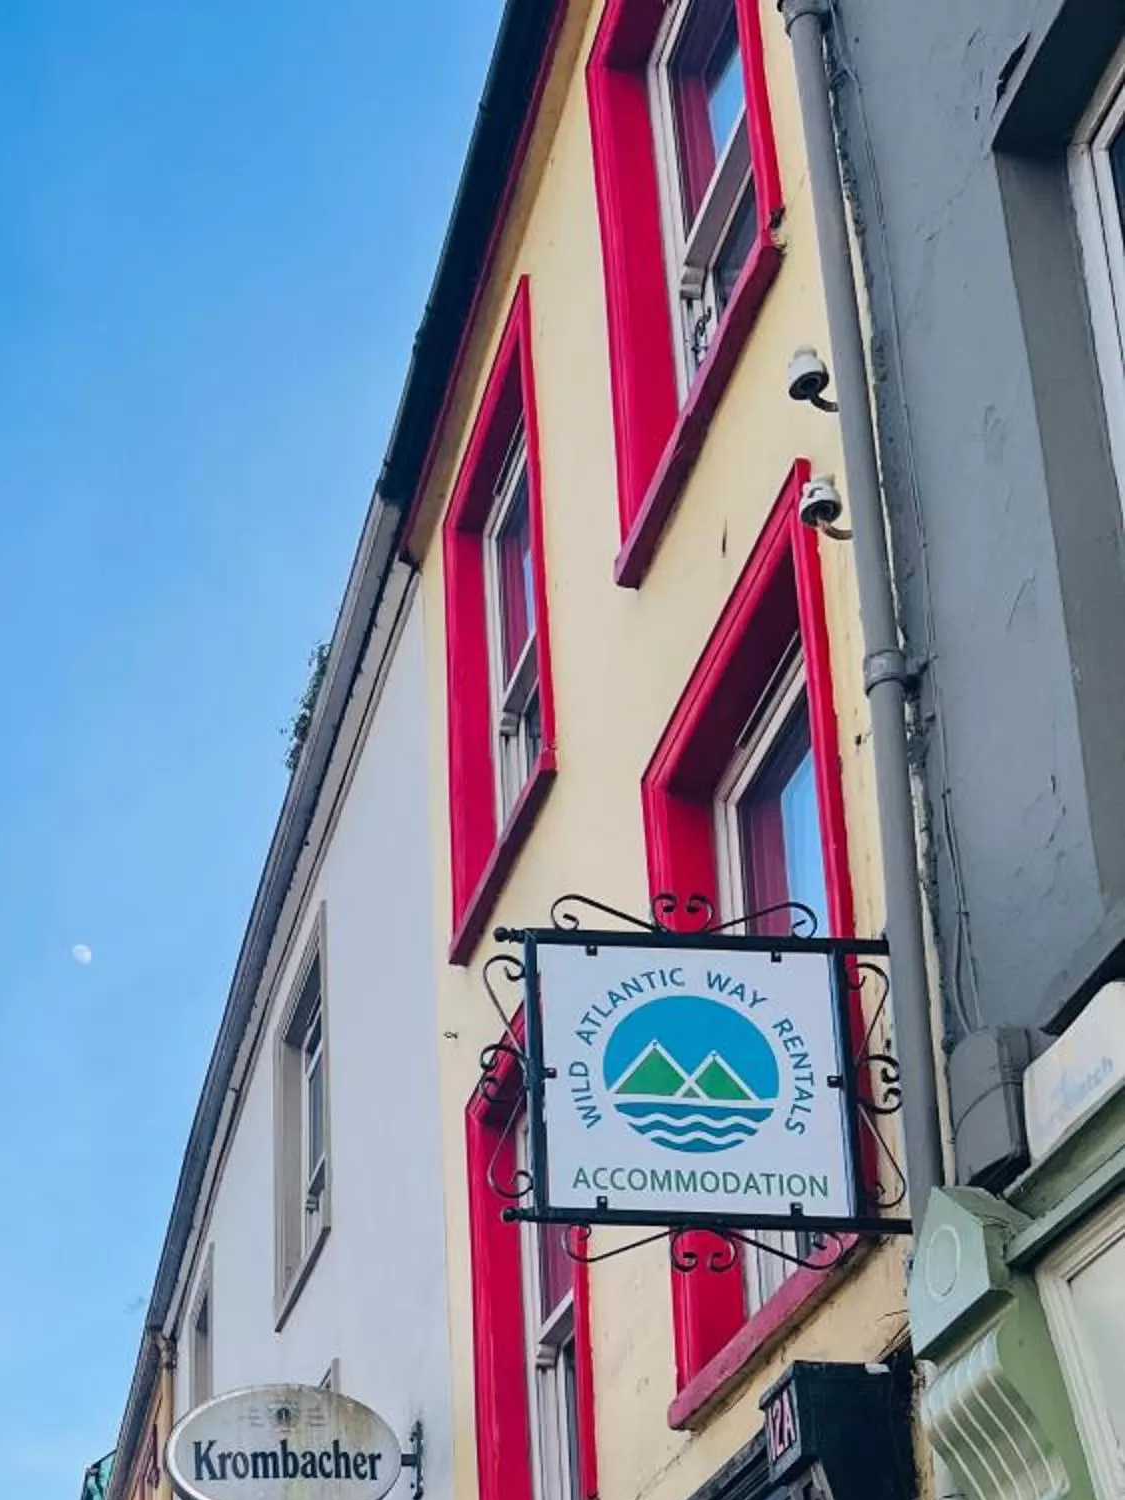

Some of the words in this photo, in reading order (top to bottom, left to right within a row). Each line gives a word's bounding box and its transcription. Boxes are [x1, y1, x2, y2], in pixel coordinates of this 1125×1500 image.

[574, 967, 686, 1046] ATLANTIC
[706, 970, 768, 1010] WAY
[569, 1060, 602, 1129] WILD
[772, 1018, 815, 1136] RENTALS
[572, 1166, 829, 1198] ACCOMMODATION
[192, 1438, 382, 1481] Krombacher
